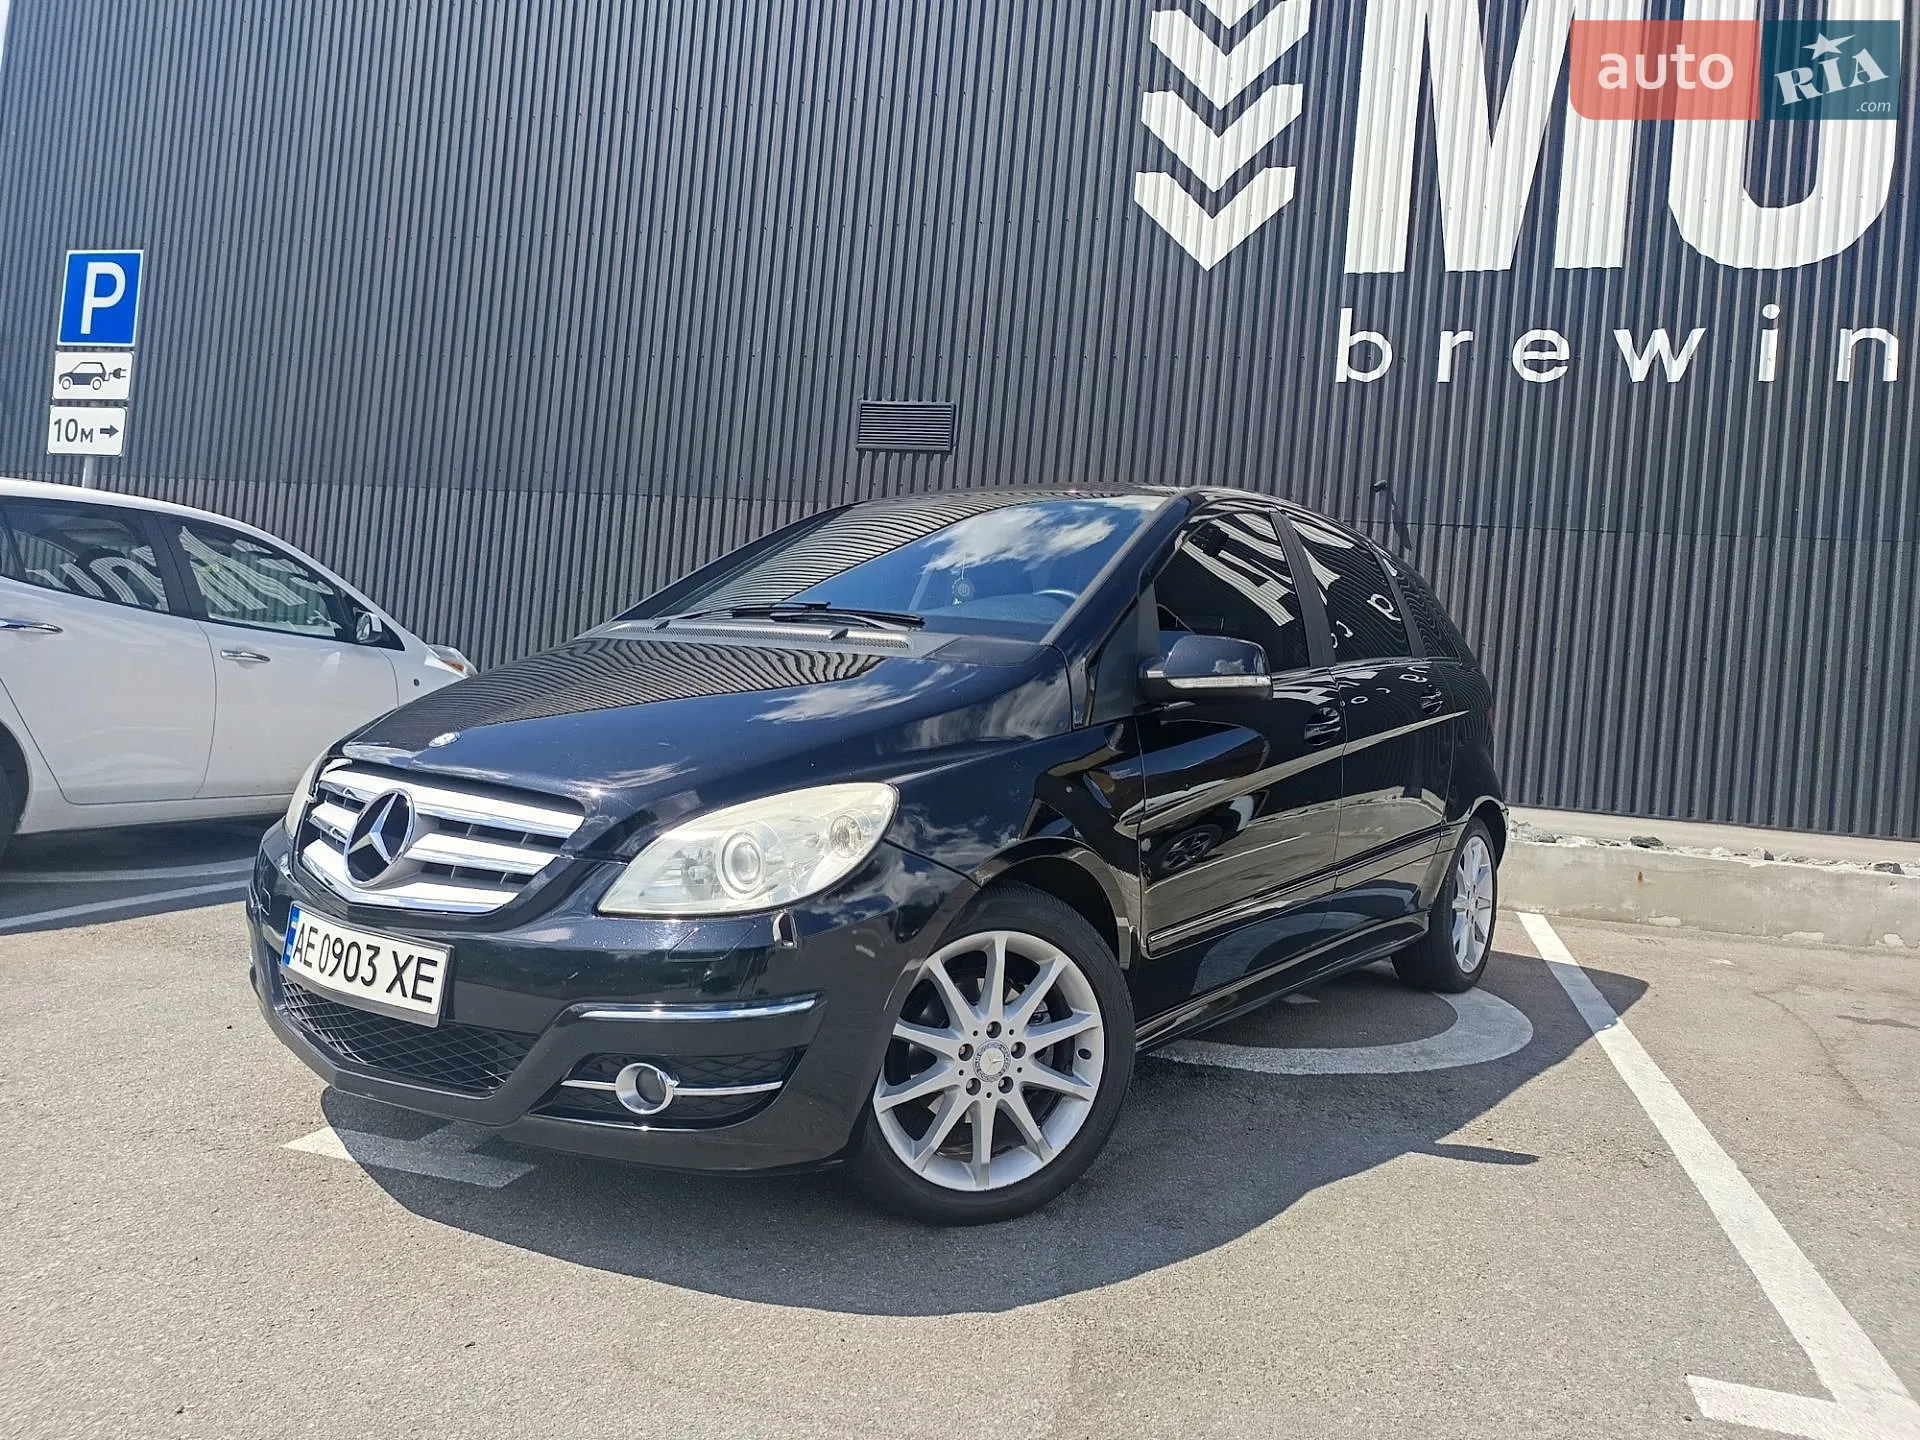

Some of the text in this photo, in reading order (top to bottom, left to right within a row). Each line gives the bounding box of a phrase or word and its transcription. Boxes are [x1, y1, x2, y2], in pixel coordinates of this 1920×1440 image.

[82, 262, 126, 335] P
[1335, 303, 1899, 383] brewin
[318, 934, 380, 987] 0903
[386, 950, 438, 1003] XE
